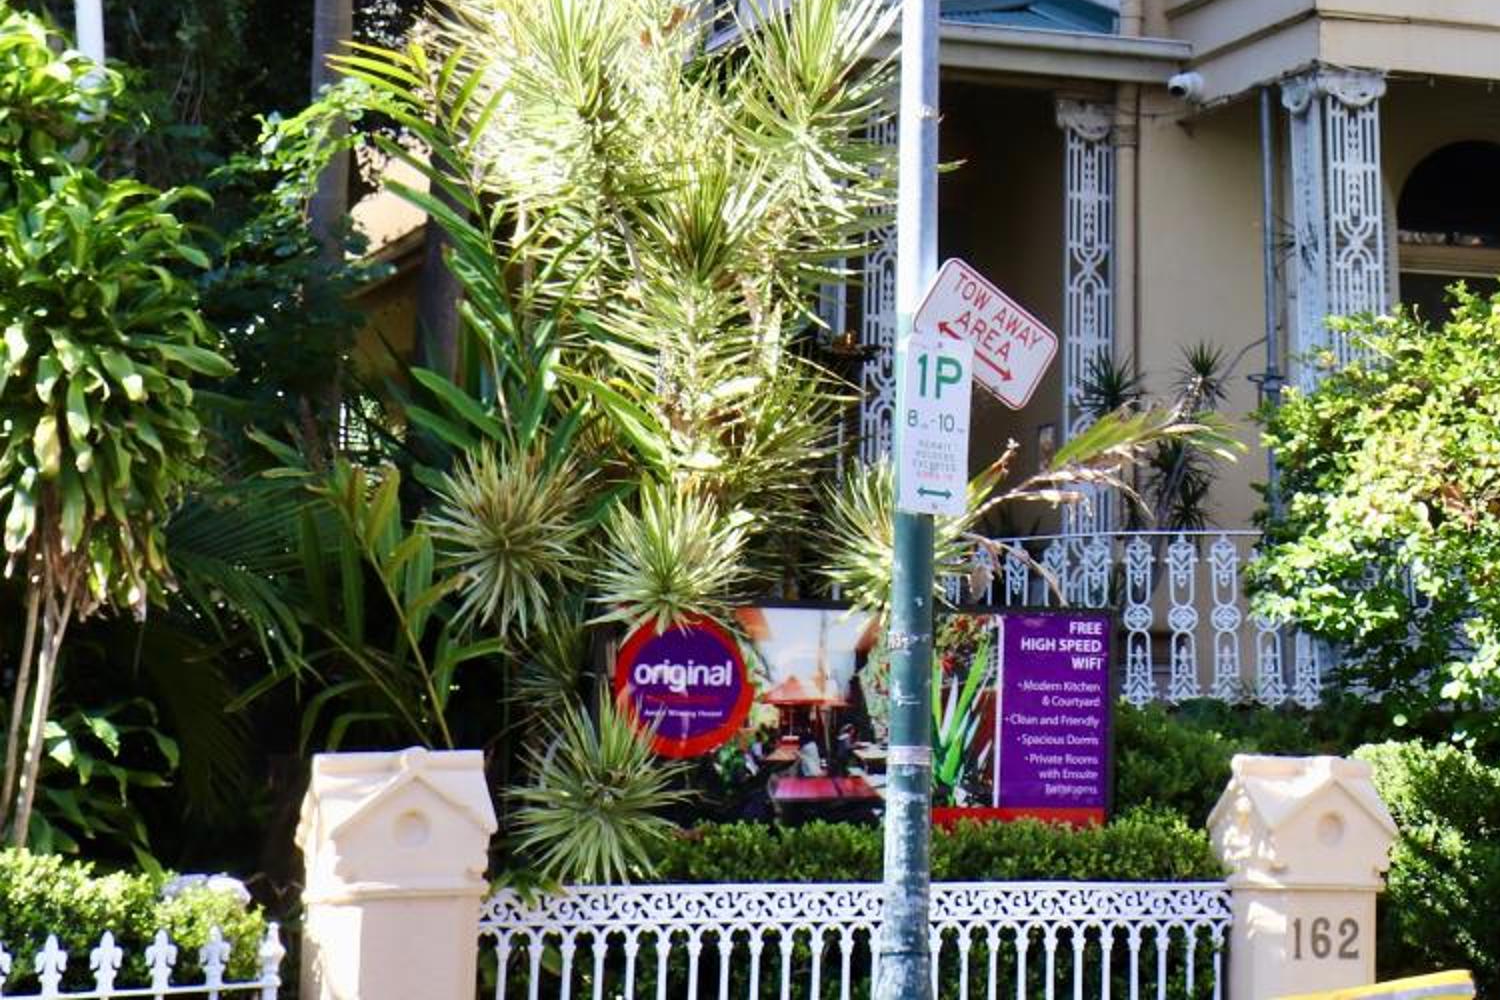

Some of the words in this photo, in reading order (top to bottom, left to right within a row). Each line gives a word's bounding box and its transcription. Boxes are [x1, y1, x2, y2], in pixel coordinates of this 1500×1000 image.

[953, 272, 992, 312] TOW
[991, 307, 1044, 351] AWAY
[954, 310, 1013, 362] AREA
[917, 353, 963, 399] 1P
[1021, 637, 1057, 651] HIGH
[1058, 639, 1103, 653] SPEED
[1069, 621, 1103, 635] FREE
[634, 659, 733, 693] original
[1063, 681, 1101, 692] Kitchen
[1040, 716, 1059, 725] and
[1060, 715, 1100, 729] Friendly
[1293, 917, 1359, 960] 162
